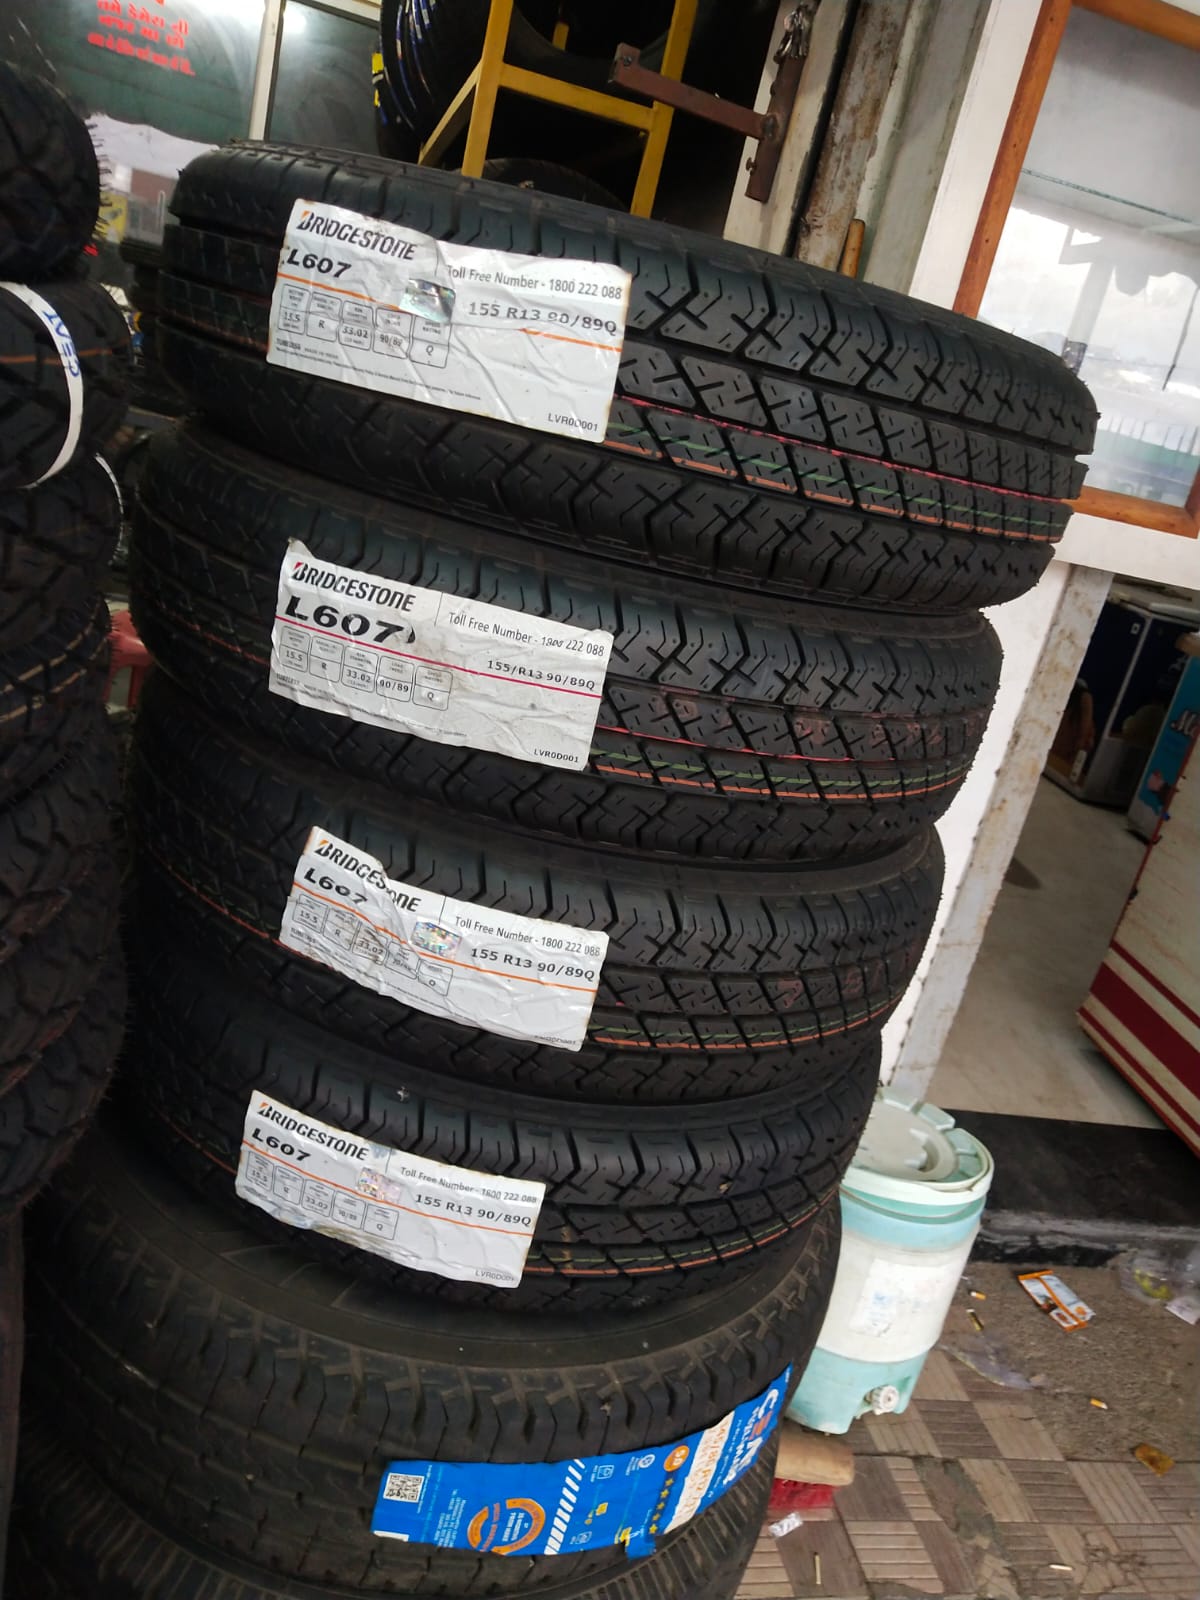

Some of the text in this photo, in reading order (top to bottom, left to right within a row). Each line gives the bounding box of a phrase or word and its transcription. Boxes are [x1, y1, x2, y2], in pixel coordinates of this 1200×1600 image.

[296, 210, 417, 261] BRIDGESTONE
[287, 248, 352, 278] L607
[448, 265, 466, 279] Toll
[469, 270, 491, 282] Free
[494, 272, 539, 289] Number
[549, 279, 575, 294] 1800
[578, 283, 598, 297] 222
[602, 286, 622, 300] 088
[318, 320, 325, 329] R
[469, 302, 501, 317] 155
[506, 307, 541, 321] R13
[425, 345, 434, 356] Q
[292, 562, 416, 612] BRIDGESTONE
[450, 612, 466, 626] Toll
[468, 618, 489, 632] Free
[493, 624, 533, 643] Number
[566, 640, 583, 652] 222
[586, 644, 605, 657] 088
[487, 659, 595, 692] 155/R13 90/89Q
[427, 691, 434, 701] Q
[304, 868, 368, 905] L607
[314, 839, 421, 912] BRIDGESONE
[456, 916, 472, 928] Toll
[474, 922, 494, 935] Free
[496, 928, 533, 944] Number
[541, 937, 563, 949] 1800
[565, 942, 582, 954] 222
[471, 948, 595, 983] 155 R13 90/89Q
[252, 1128, 312, 1162] L607
[257, 1102, 370, 1161] BRIDGESTONE
[401, 1167, 416, 1178] Toll
[418, 1172, 438, 1183] Free
[439, 1177, 474, 1192] Number
[376, 1222, 384, 1231] Q
[415, 1194, 532, 1227] 155 R13 90/89Q
